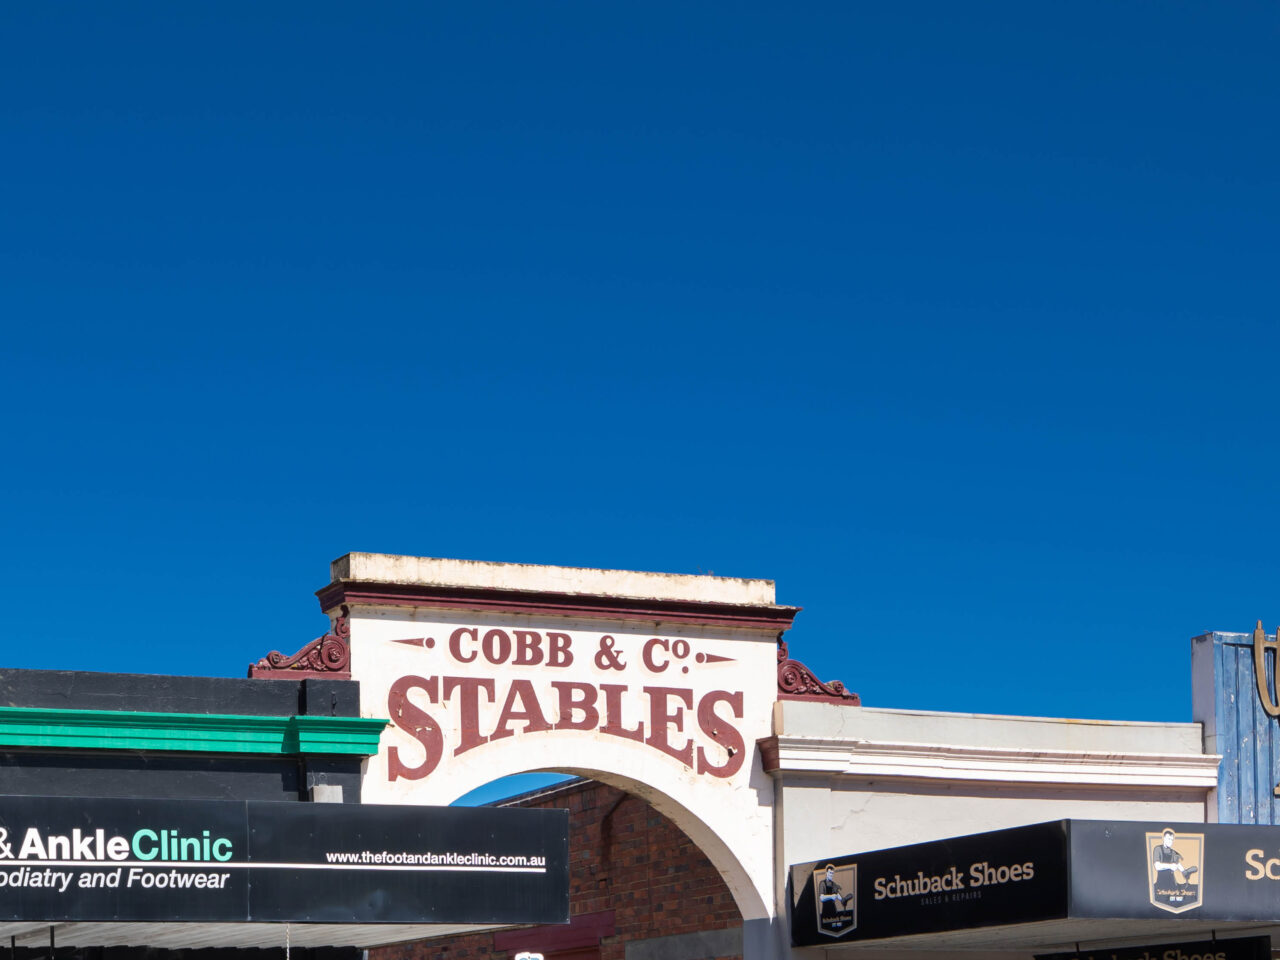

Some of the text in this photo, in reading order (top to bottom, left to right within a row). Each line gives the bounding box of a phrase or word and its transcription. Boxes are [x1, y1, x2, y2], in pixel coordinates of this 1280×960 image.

[449, 627, 574, 668] COBB
[594, 634, 627, 671] &
[387, 674, 746, 783] STABLES
[78, 868, 122, 888] and
[127, 868, 230, 889] Footwear
[326, 851, 545, 867] www.thefootandankleclinic.com.au
[874, 860, 1035, 901] Schuback Shoes
